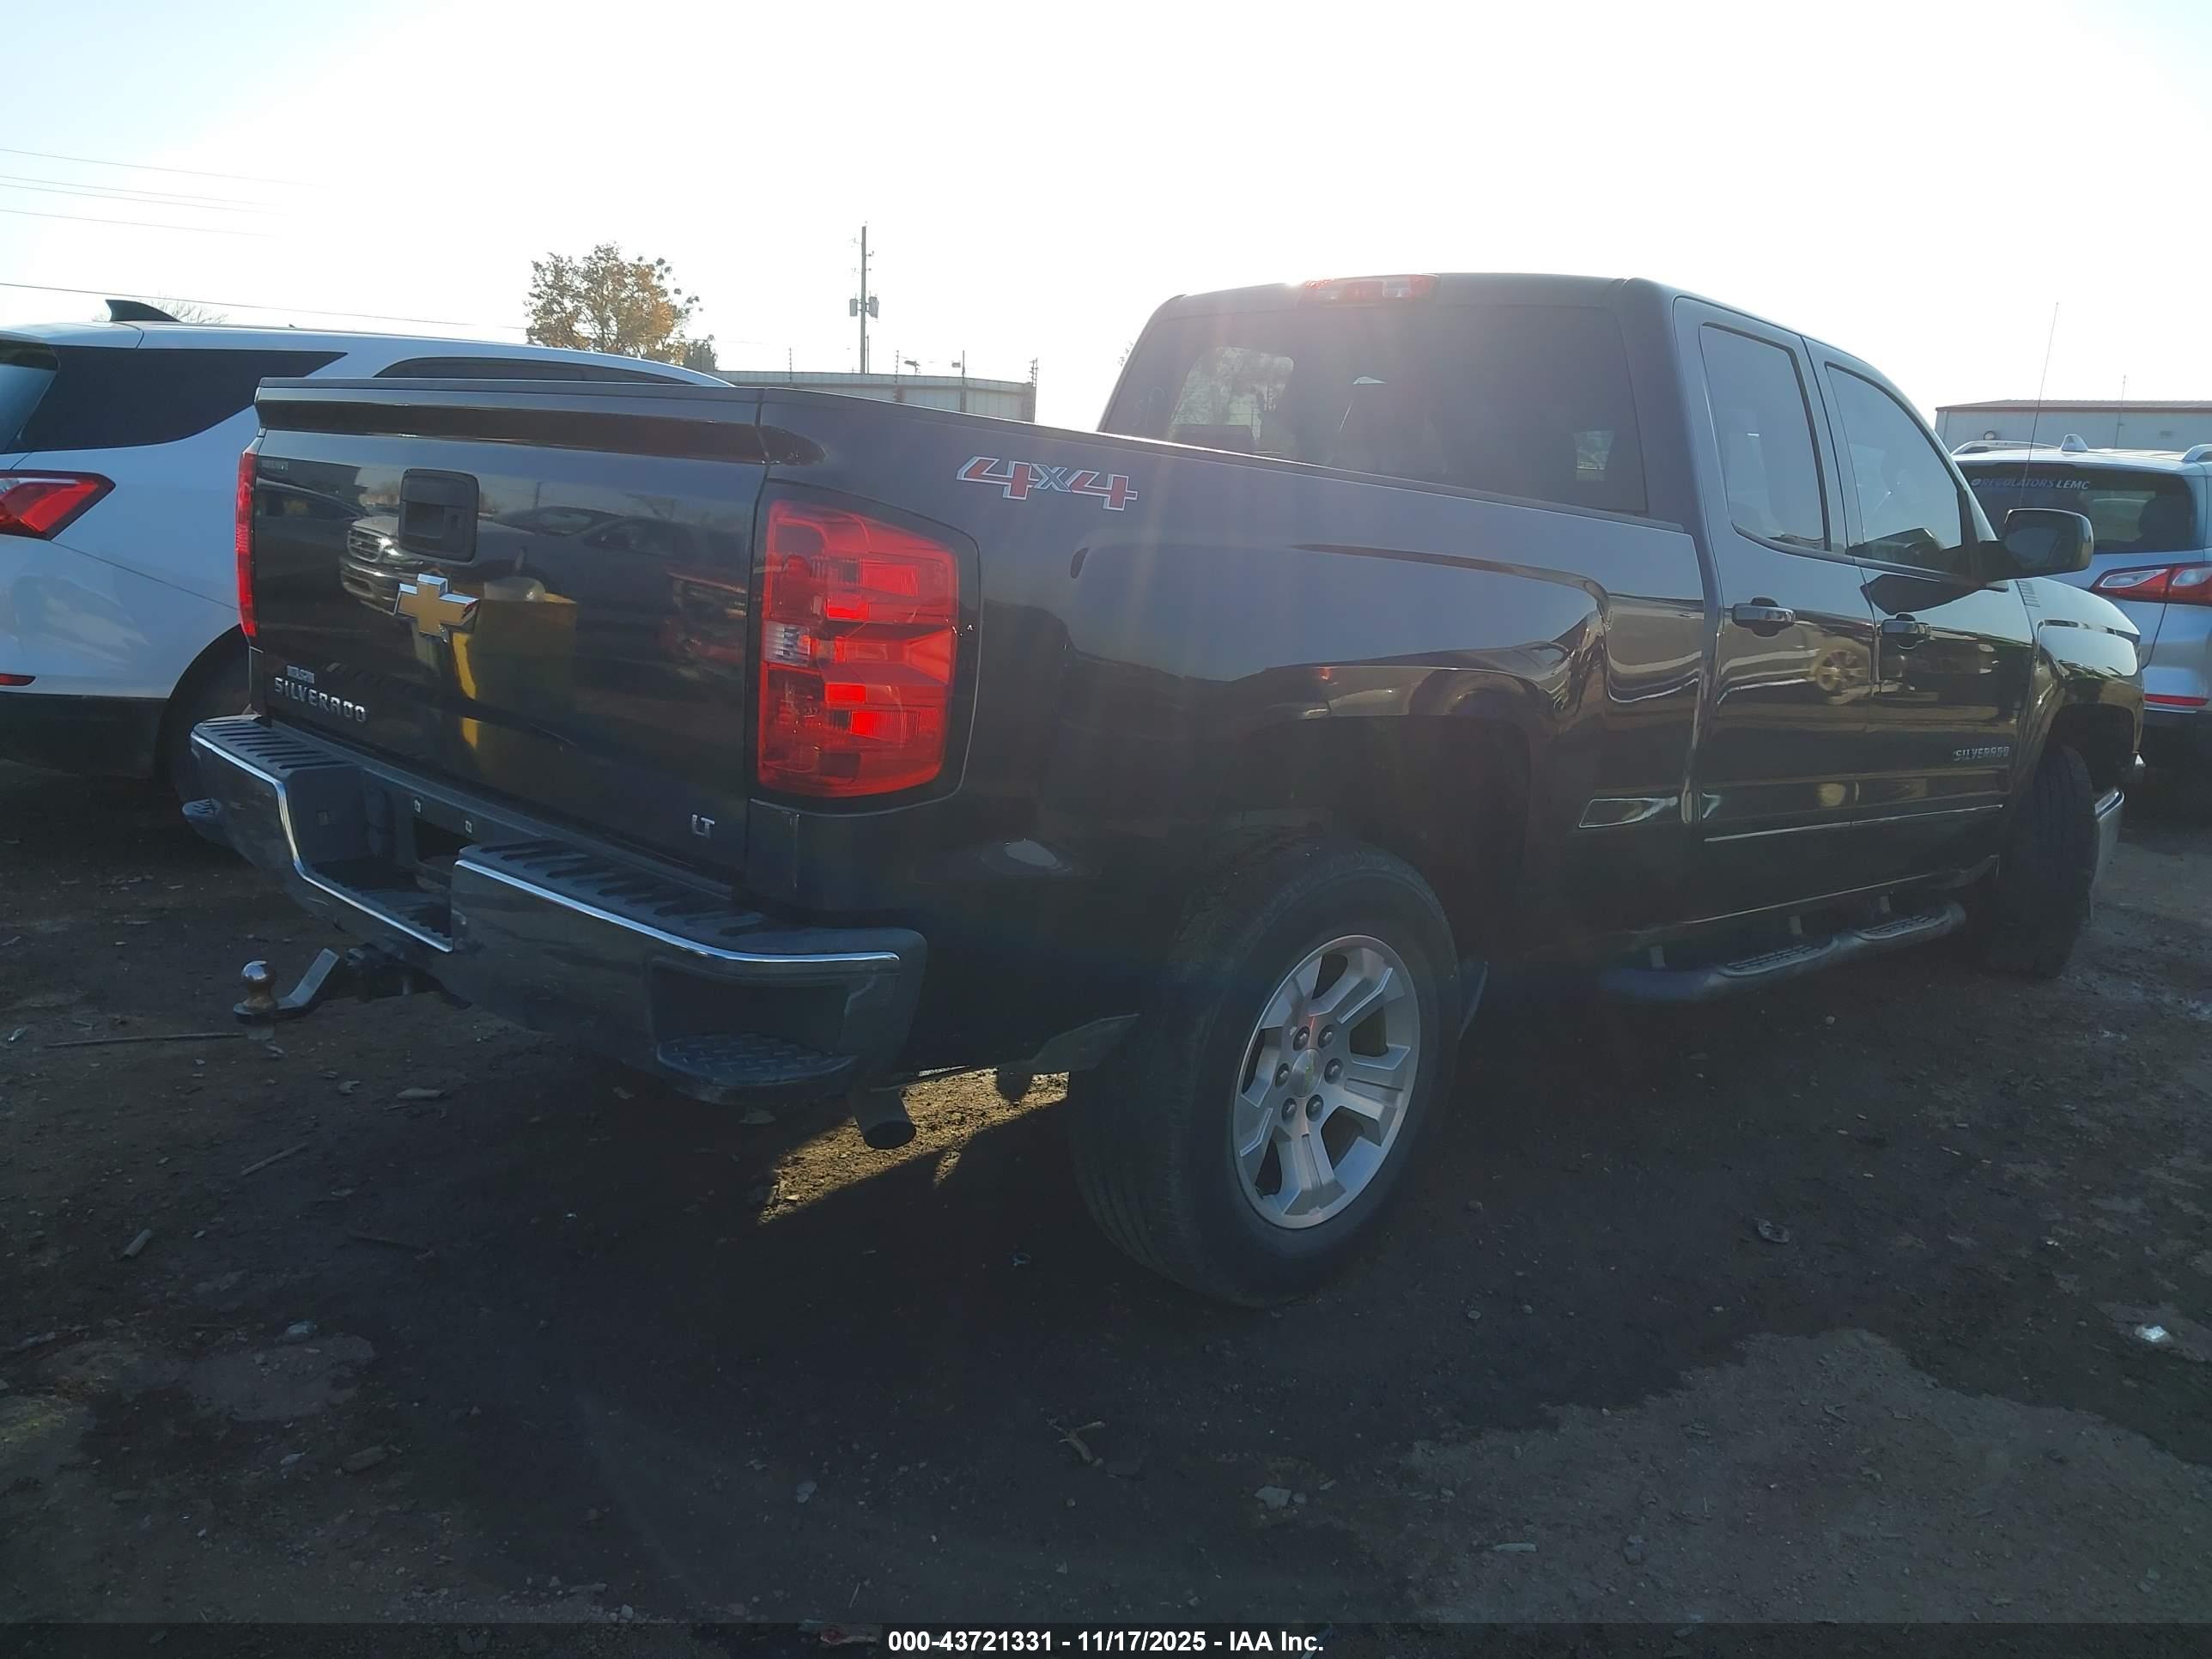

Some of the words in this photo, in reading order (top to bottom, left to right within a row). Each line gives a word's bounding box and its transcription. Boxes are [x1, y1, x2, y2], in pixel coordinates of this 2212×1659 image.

[2056, 478, 2091, 490] LEMC
[274, 677, 367, 722] SILVERADO
[1954, 746, 2010, 761] SILVERADO
[691, 814, 715, 838] LT
